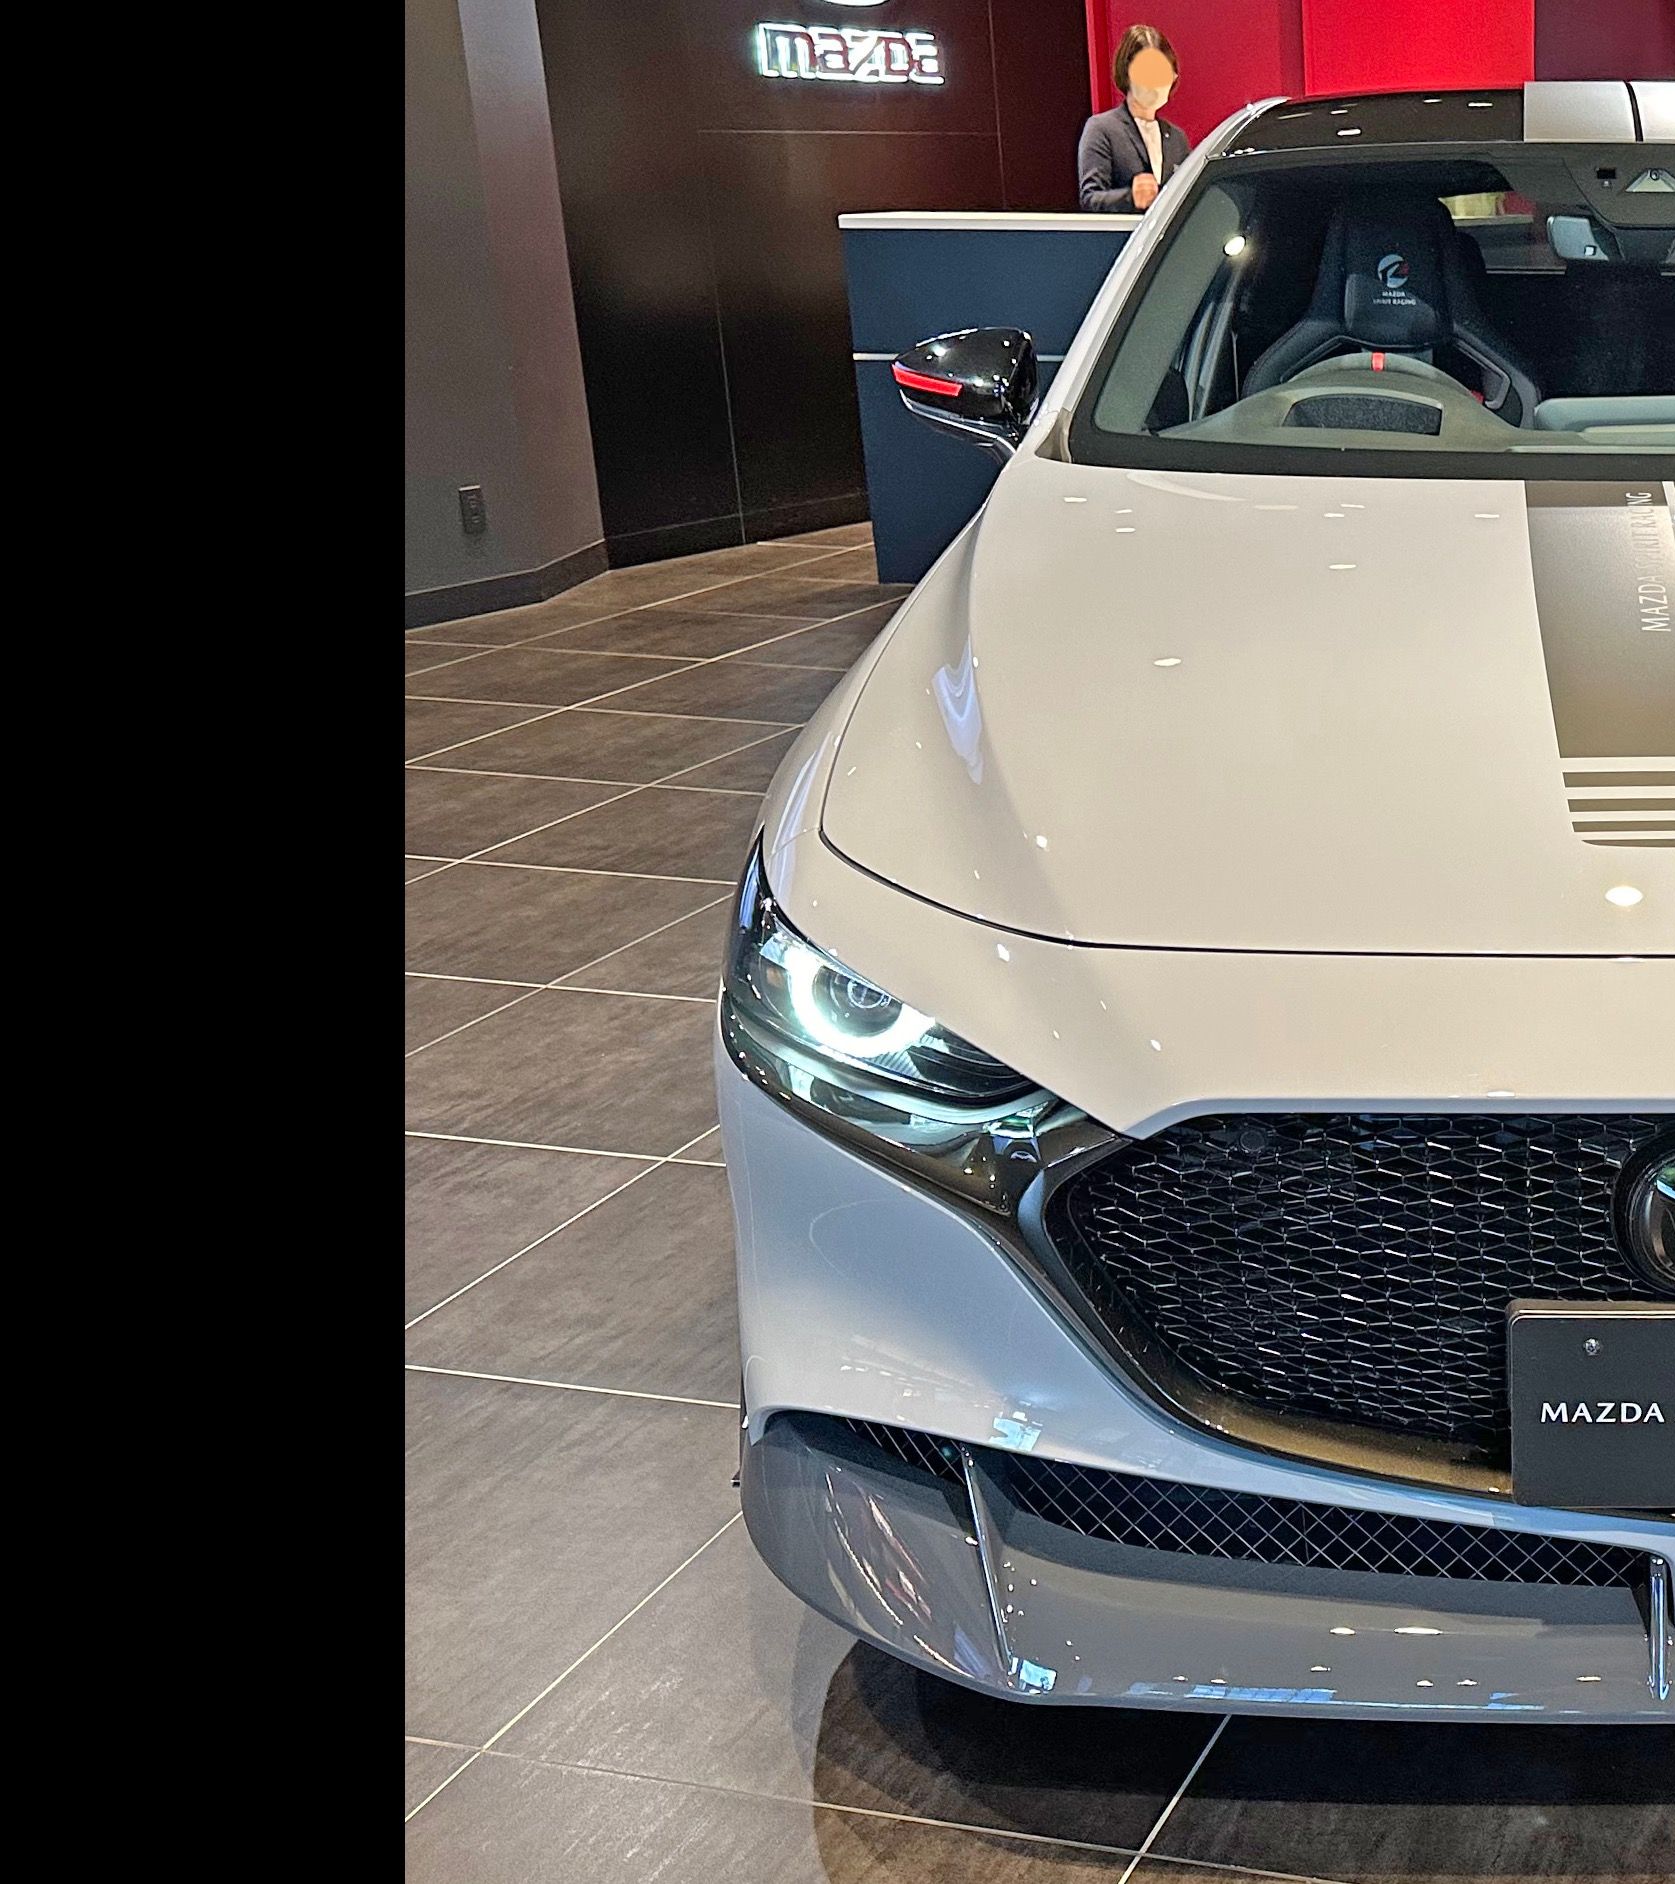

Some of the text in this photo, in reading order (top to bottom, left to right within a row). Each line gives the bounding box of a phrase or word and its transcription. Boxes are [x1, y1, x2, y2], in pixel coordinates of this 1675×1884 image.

[757, 22, 945, 85] mazda
[1625, 492, 1656, 529] RACNG
[1637, 574, 1672, 632] MAZDA
[1540, 1402, 1665, 1424] MAZDA
